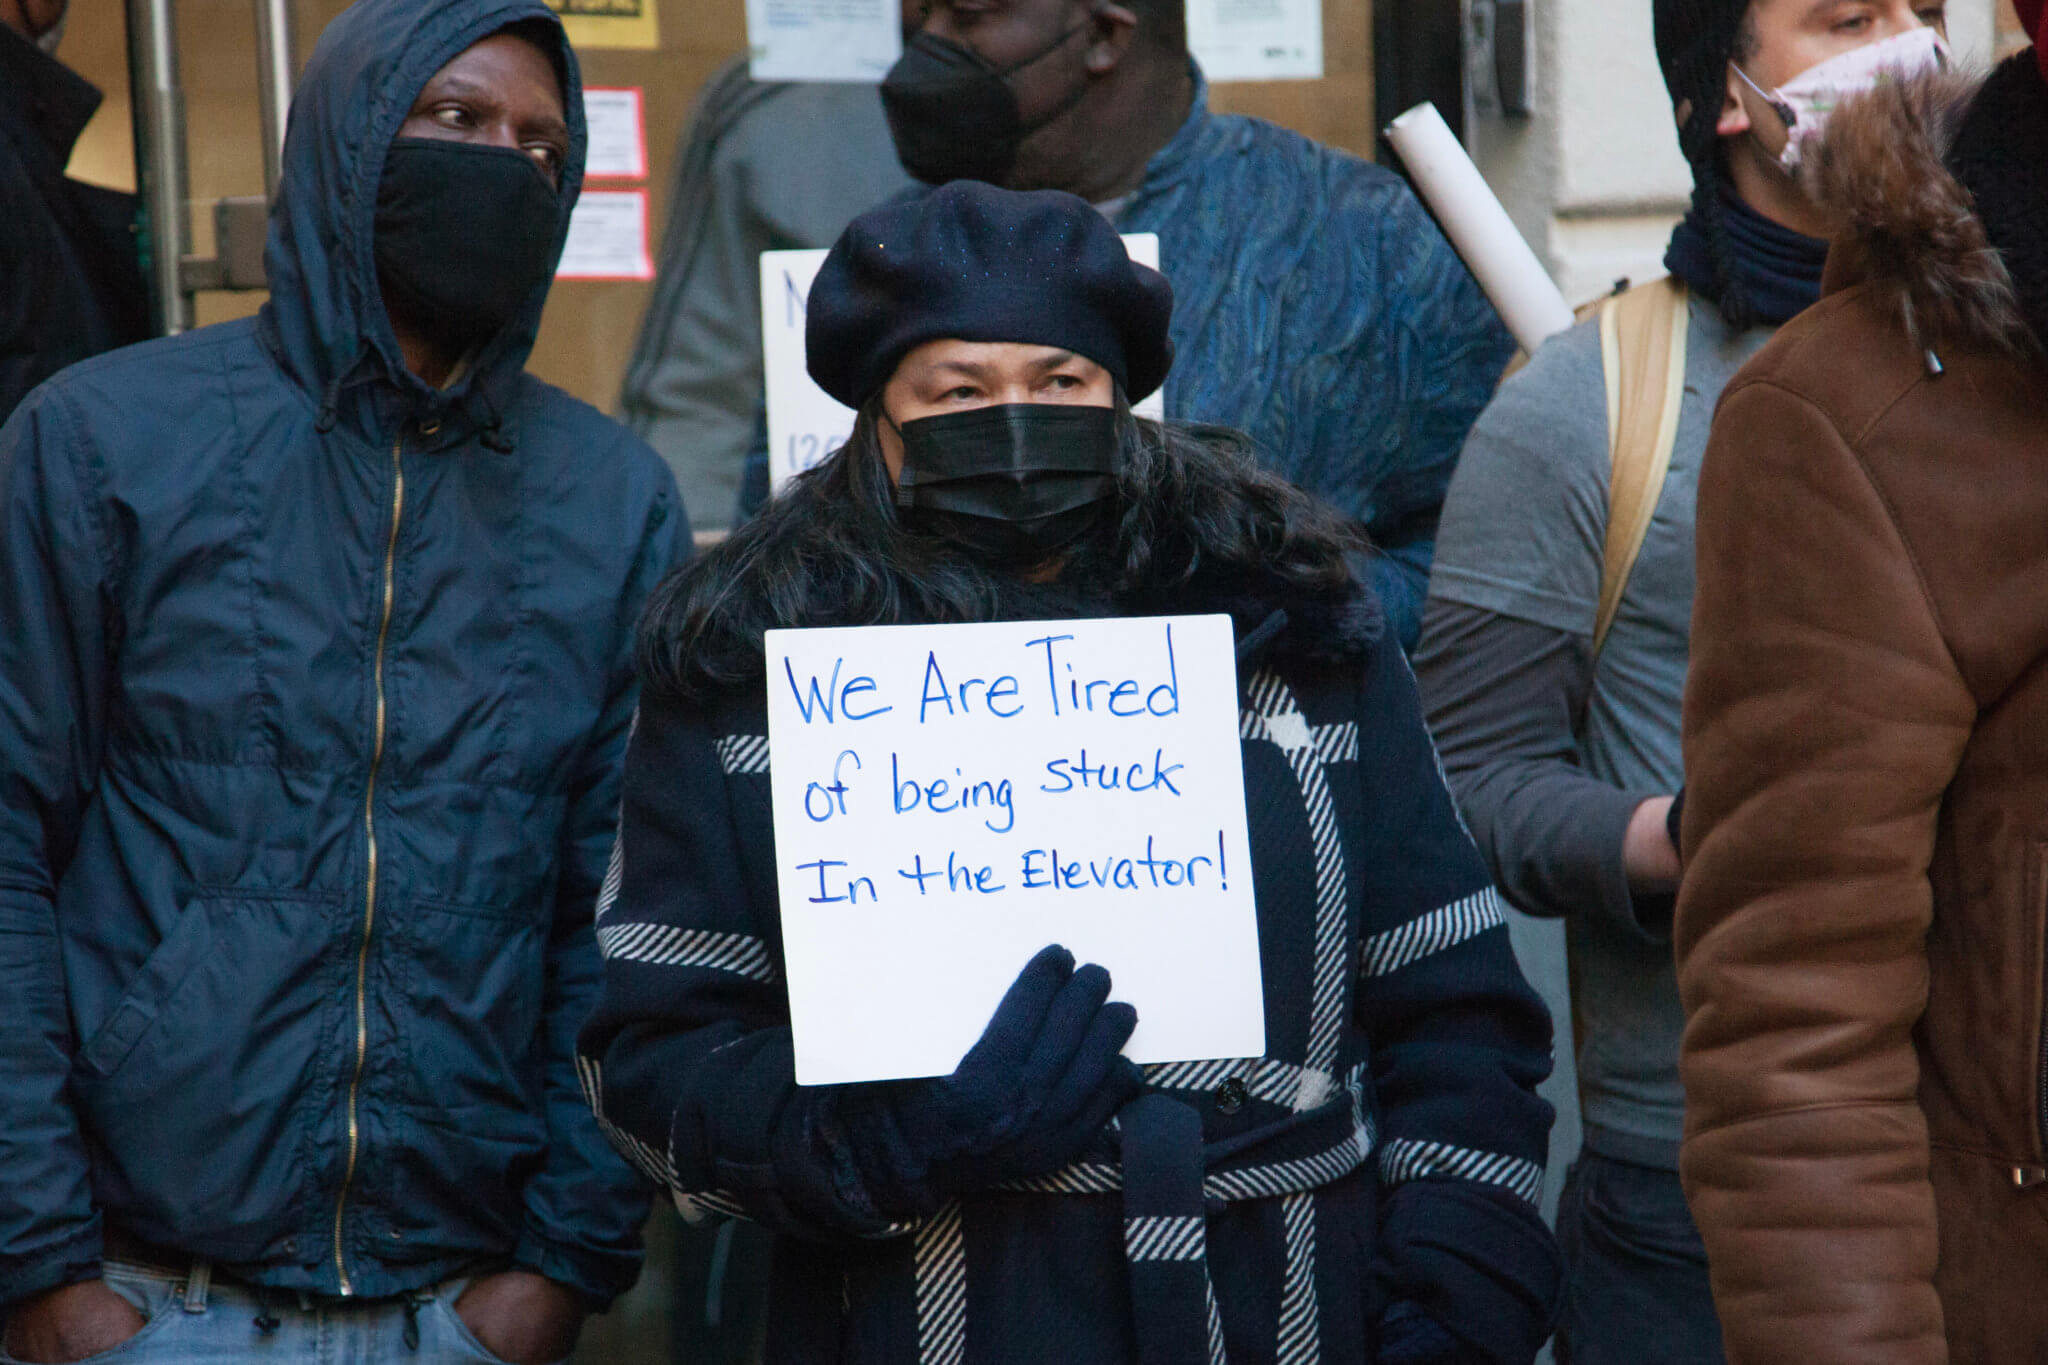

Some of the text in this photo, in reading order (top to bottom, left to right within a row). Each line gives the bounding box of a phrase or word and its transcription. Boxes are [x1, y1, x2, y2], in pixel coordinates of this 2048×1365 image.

[784, 623, 1180, 724] We Are Tired
[804, 748, 1184, 834] of being stuck
[796, 830, 1228, 904] In the Elevator!
